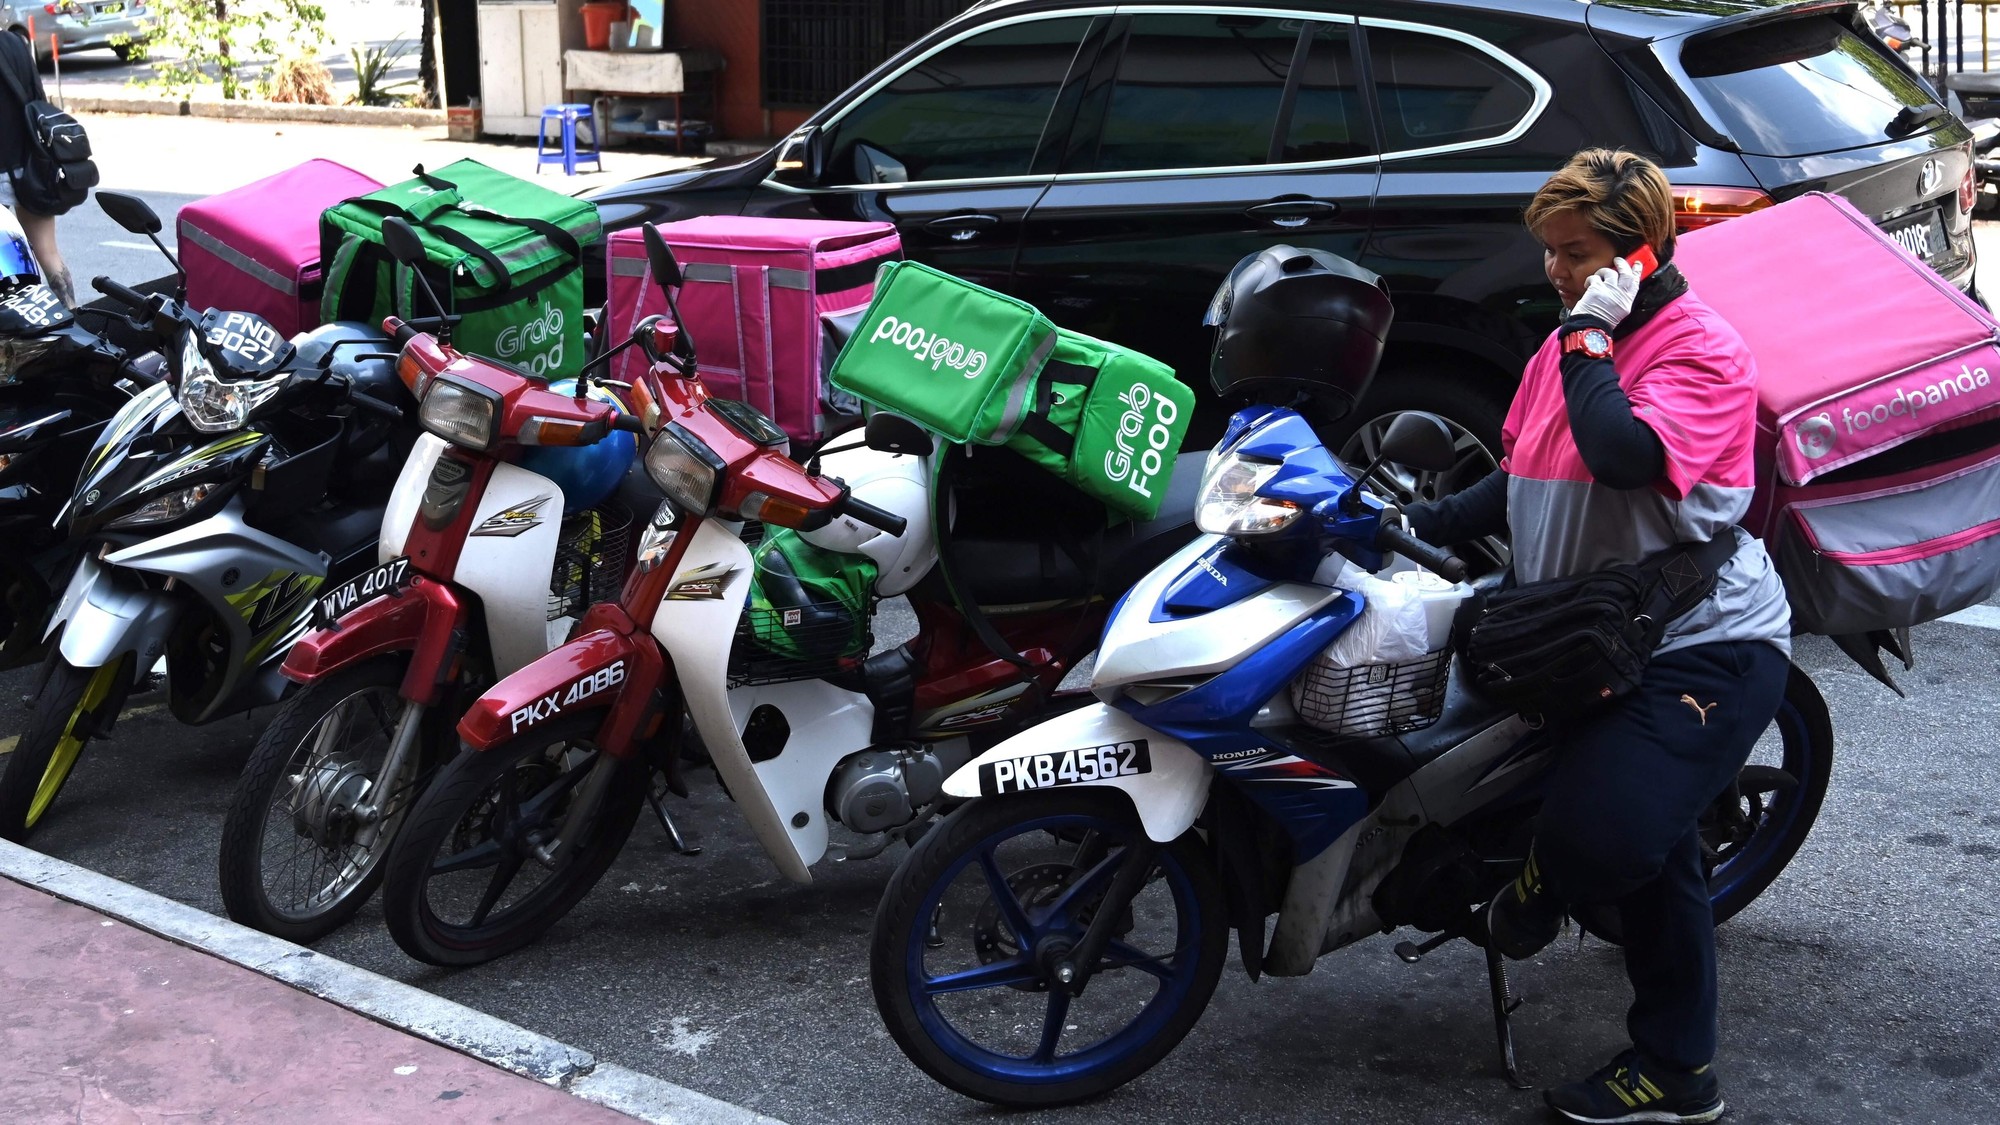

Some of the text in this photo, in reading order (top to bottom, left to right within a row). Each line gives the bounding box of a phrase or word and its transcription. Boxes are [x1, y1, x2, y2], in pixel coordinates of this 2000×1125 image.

[15, 284, 60, 311] PNH
[206, 327, 275, 365] 3027
[224, 312, 276, 348] PNQ
[495, 300, 564, 358] Grab
[517, 333, 564, 376] od
[869, 316, 988, 379] GrabFood
[1842, 364, 1991, 436] foodpanda
[1104, 382, 1151, 482] Grab
[1128, 392, 1178, 499] Food
[323, 559, 408, 620] WVA 4017
[1197, 557, 1228, 587] HONDA
[511, 660, 625, 735] PKX 4086
[1212, 747, 1267, 760] HONDA
